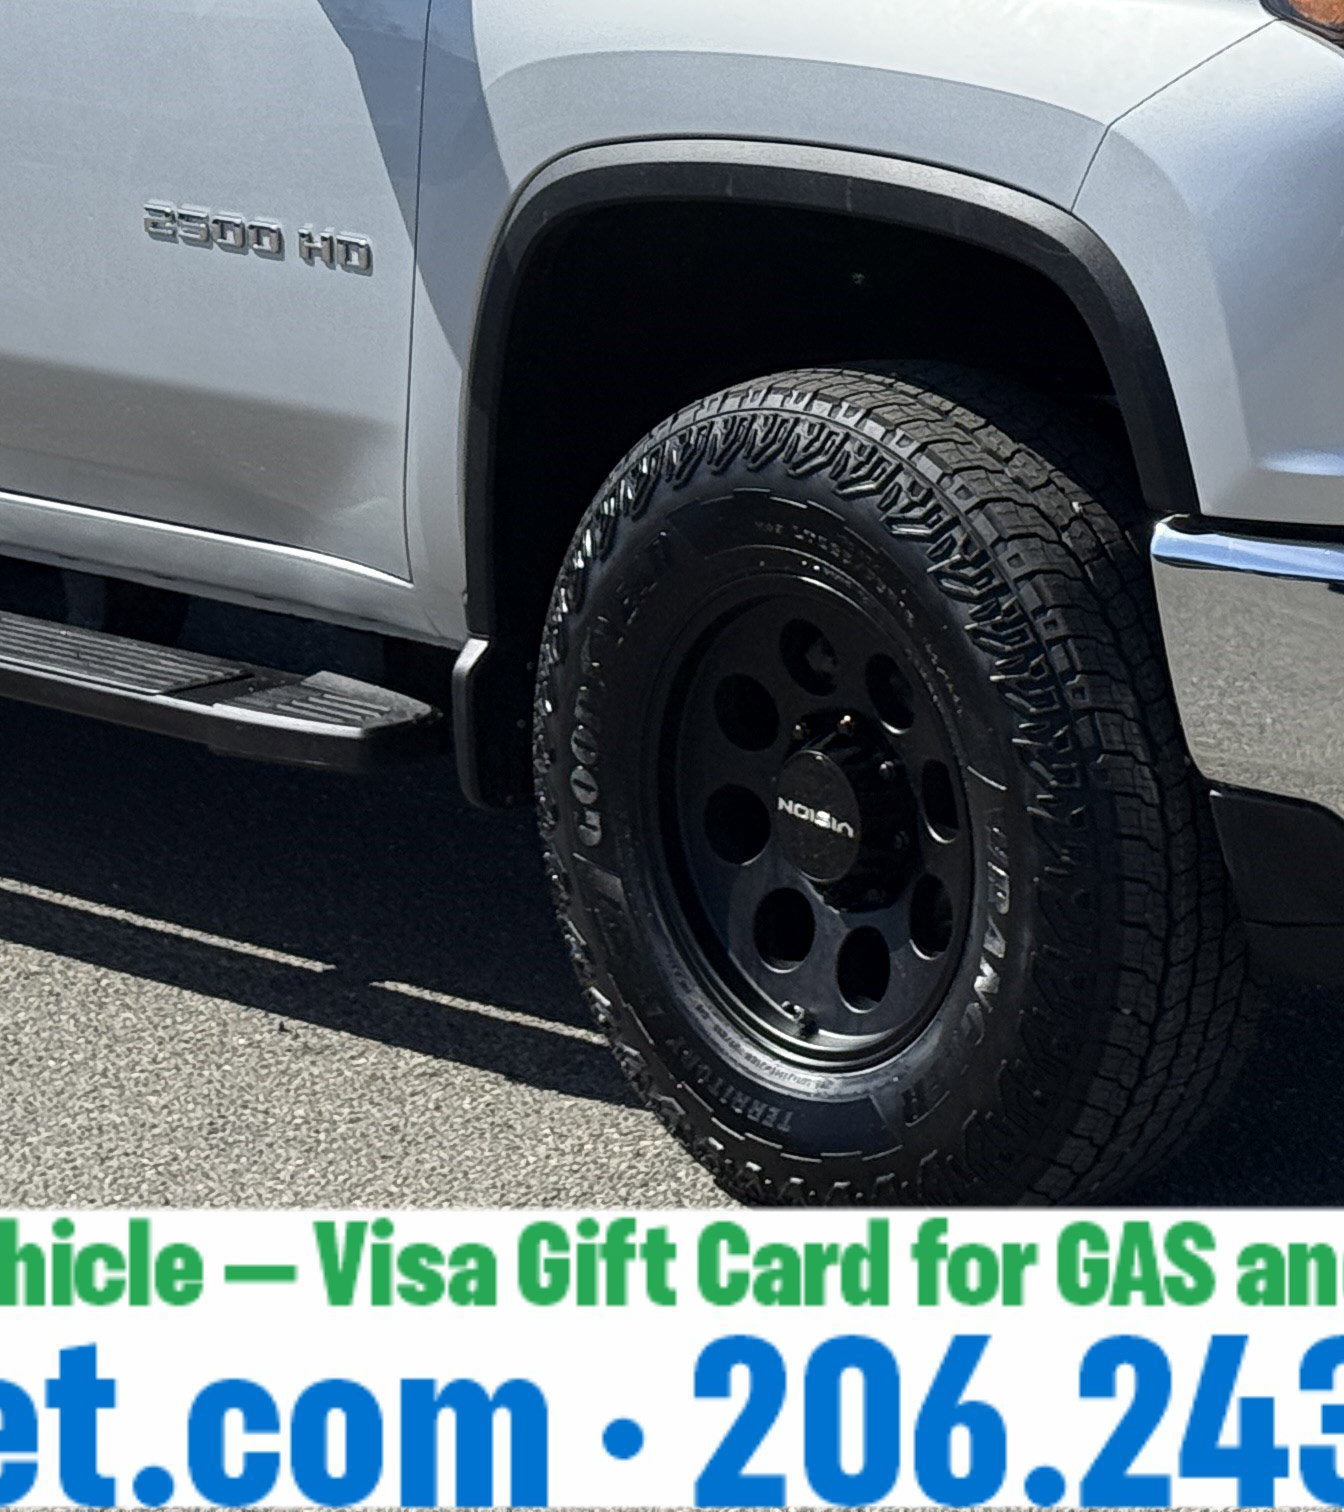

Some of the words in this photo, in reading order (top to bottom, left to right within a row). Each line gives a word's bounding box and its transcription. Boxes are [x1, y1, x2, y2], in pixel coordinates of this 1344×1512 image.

[143, 199, 284, 259] 2500
[298, 224, 373, 276] HD
[776, 795, 856, 839] VISION
